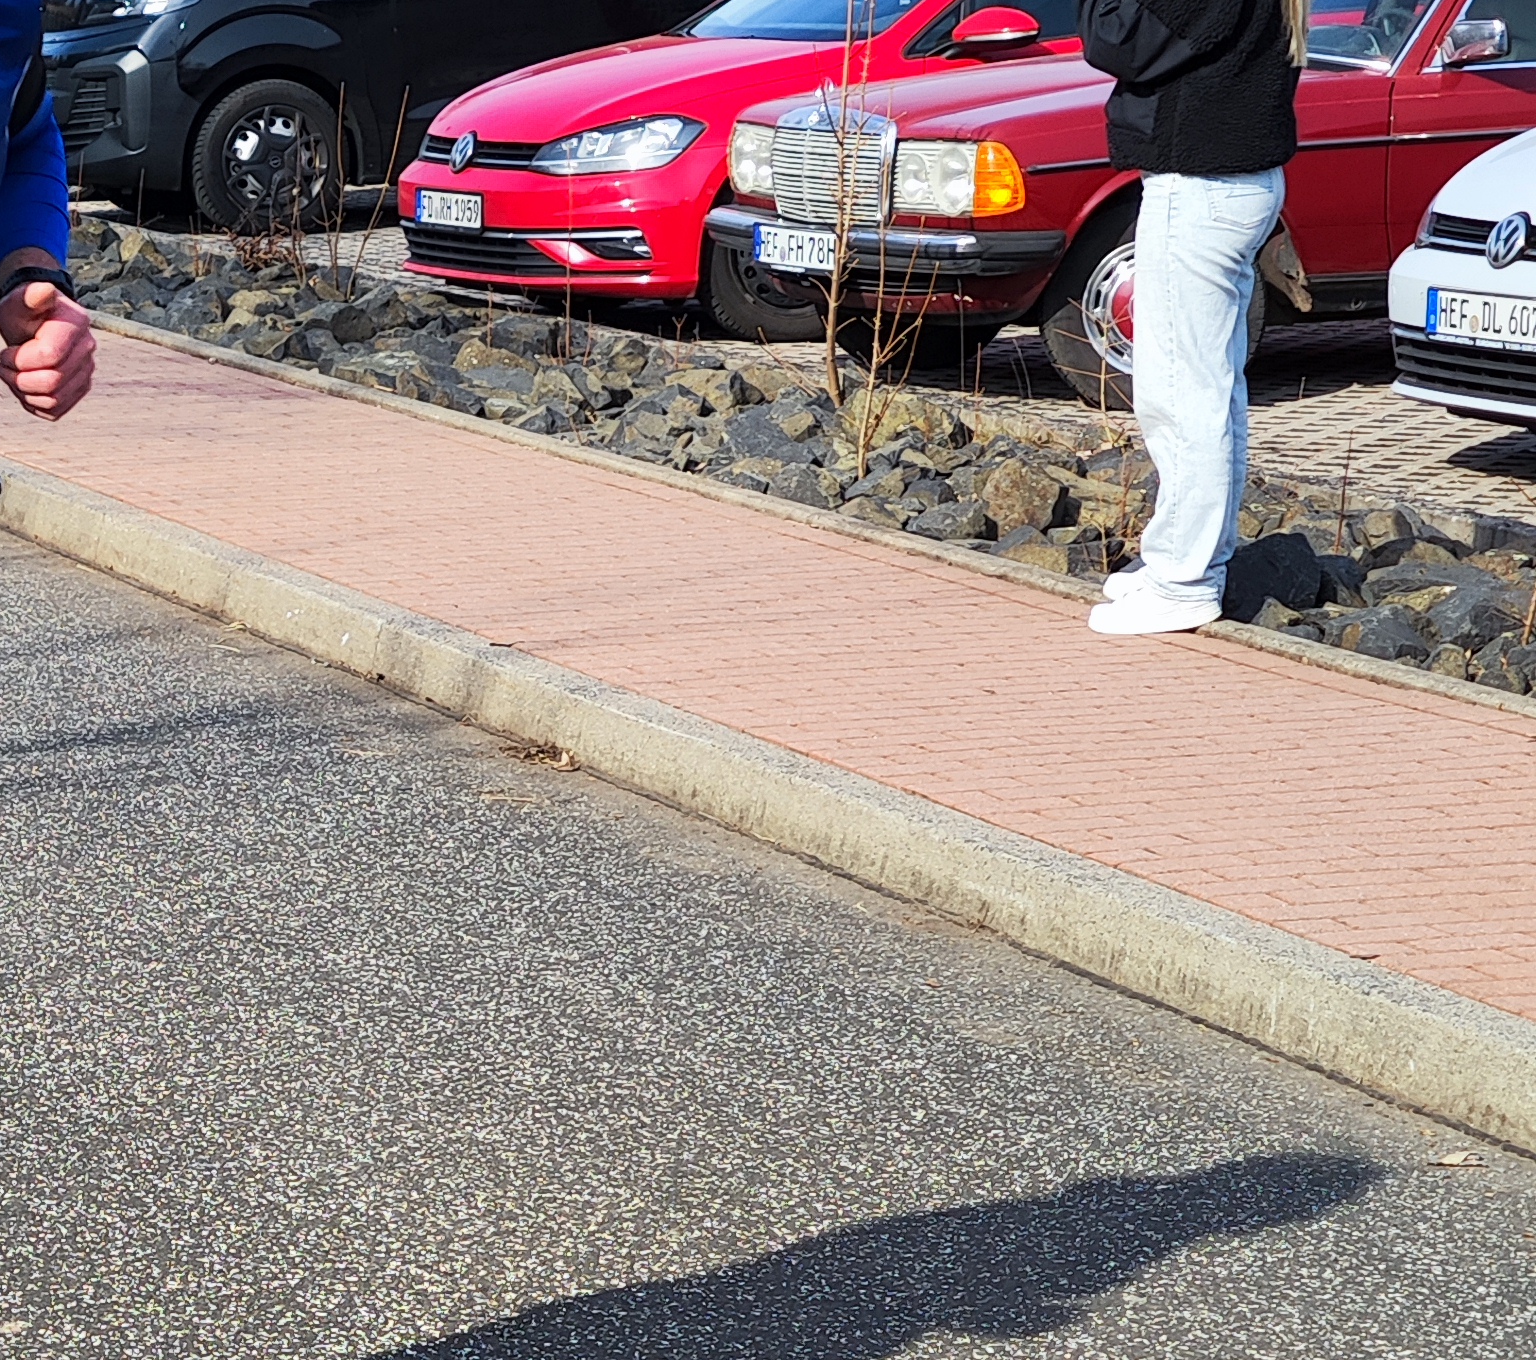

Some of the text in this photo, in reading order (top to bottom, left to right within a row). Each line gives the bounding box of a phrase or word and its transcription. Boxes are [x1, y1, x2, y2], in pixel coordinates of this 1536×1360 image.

[439, 196, 452, 221] RH
[454, 198, 480, 224] 1959
[761, 230, 778, 258] HEF
[787, 234, 805, 263] FH
[1438, 295, 1470, 330] HEF
[1481, 300, 1503, 335] DL
